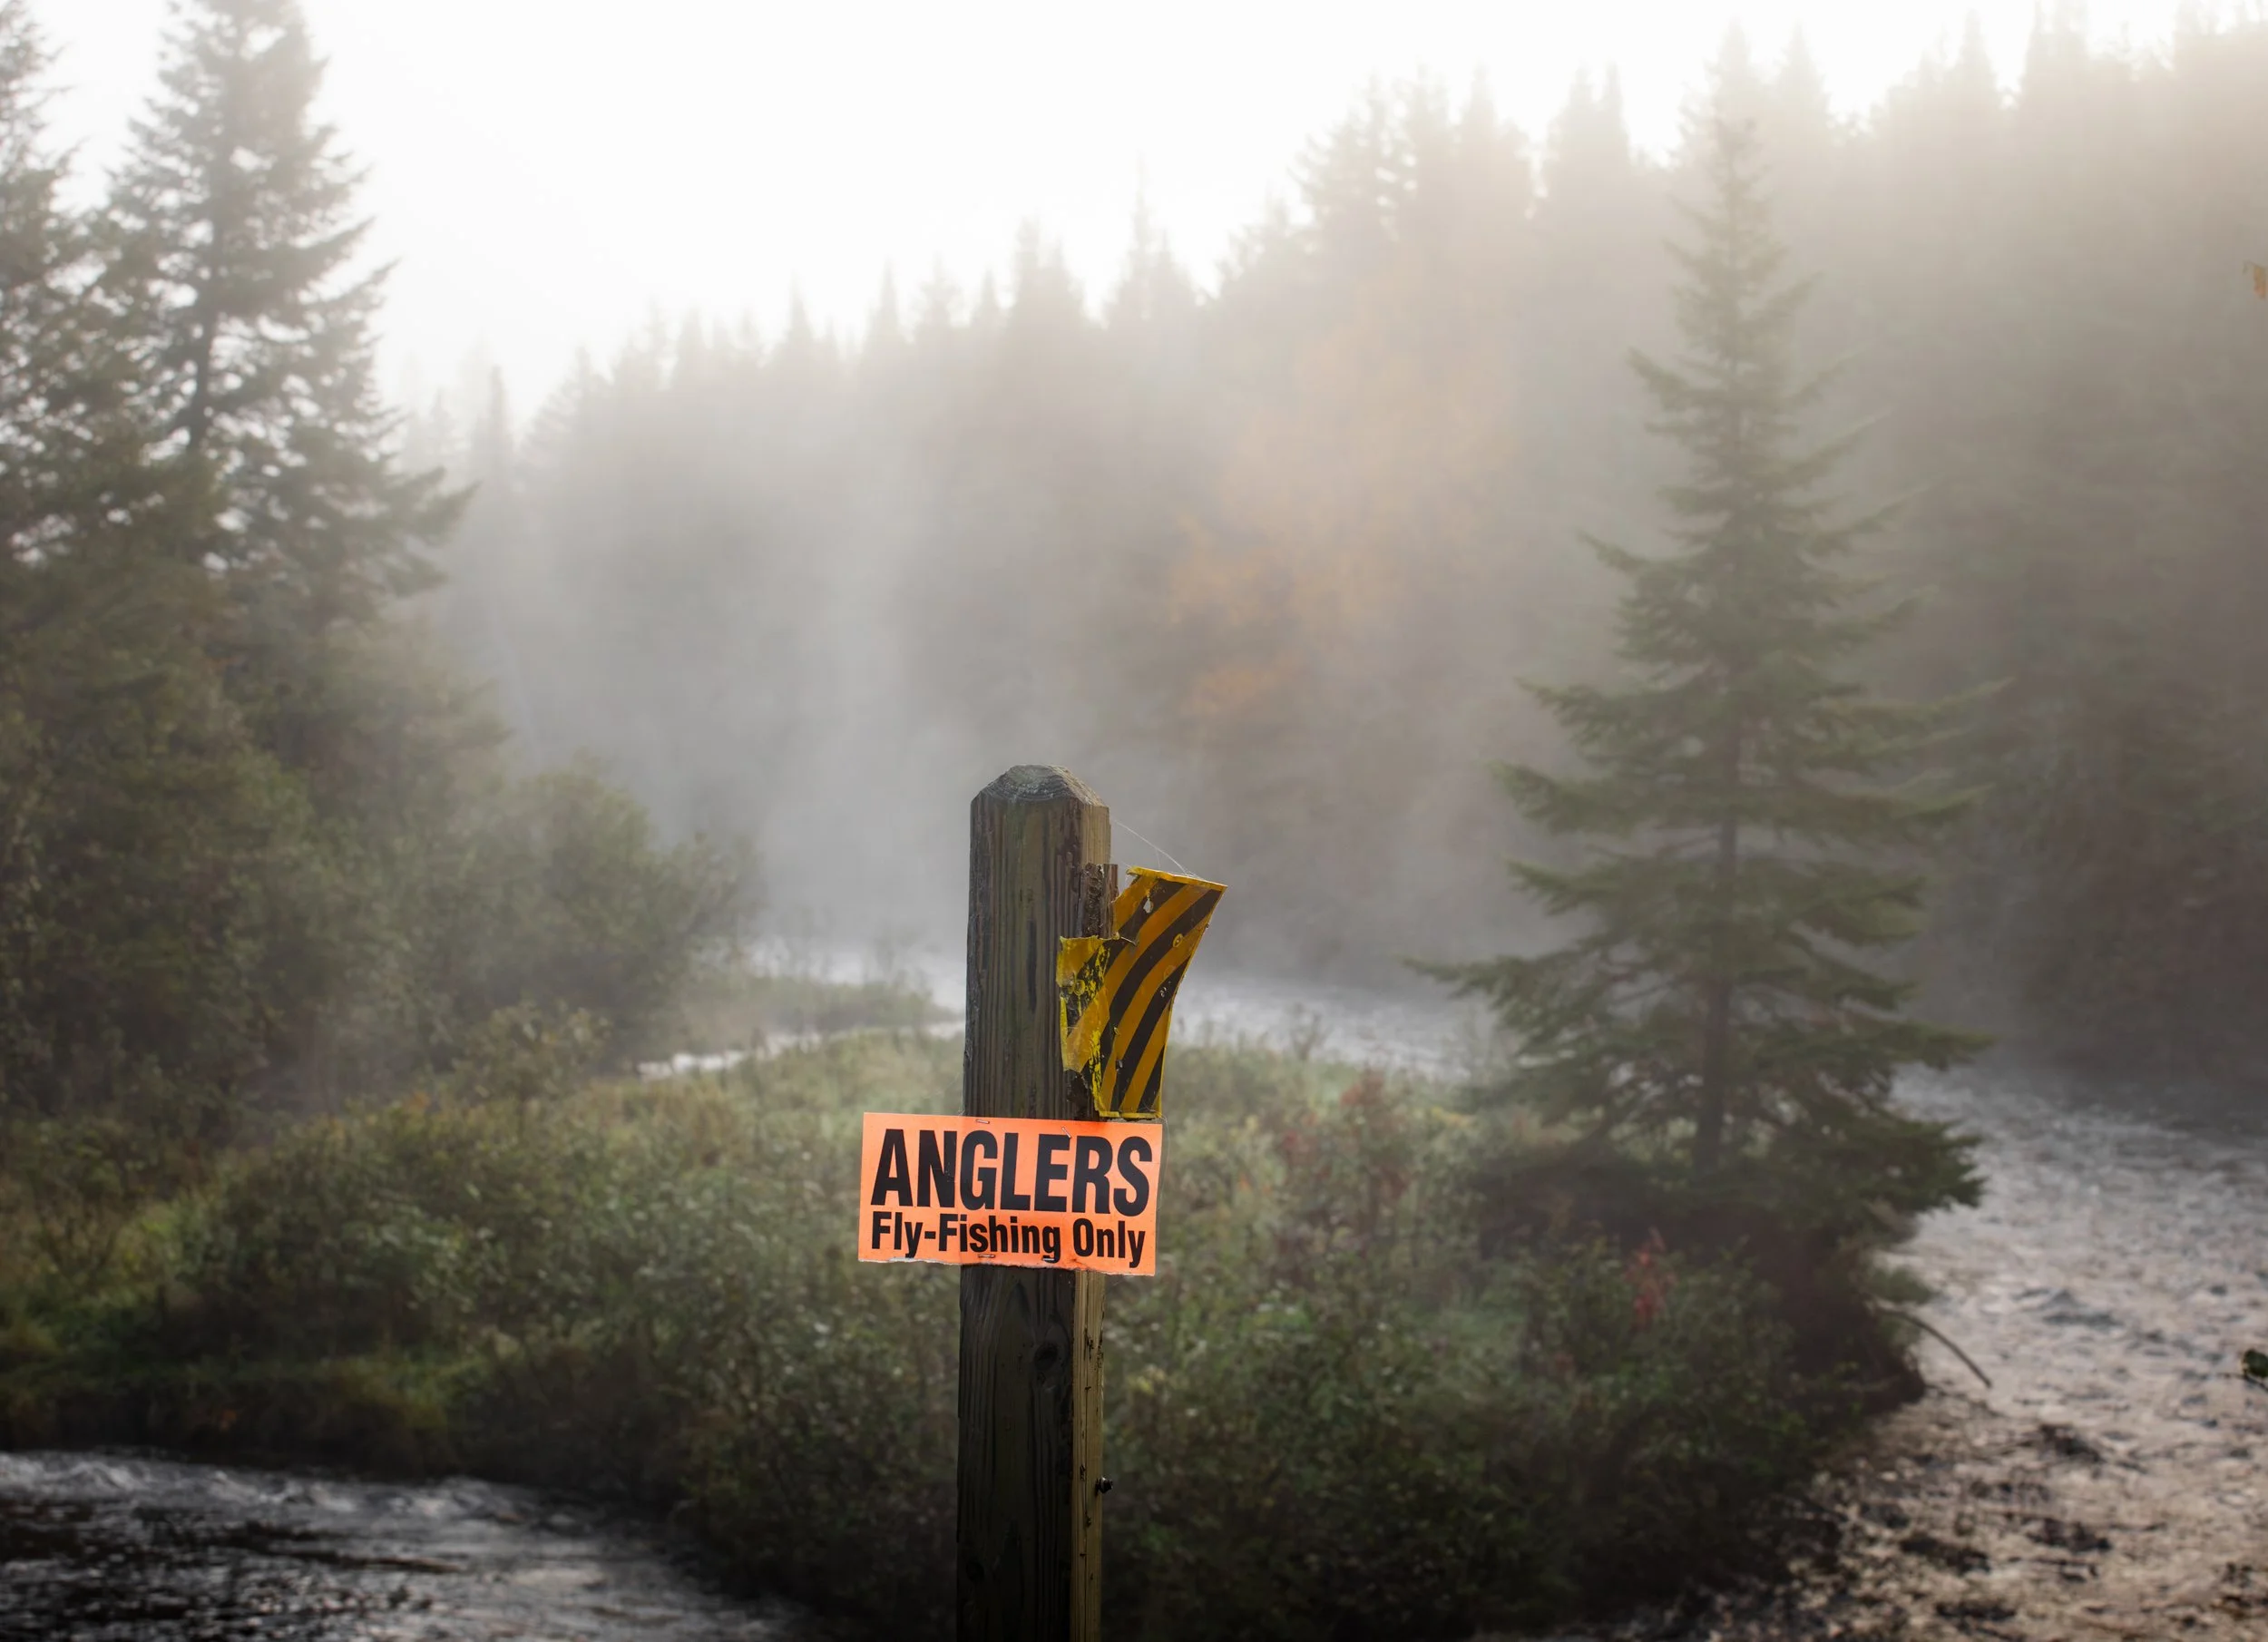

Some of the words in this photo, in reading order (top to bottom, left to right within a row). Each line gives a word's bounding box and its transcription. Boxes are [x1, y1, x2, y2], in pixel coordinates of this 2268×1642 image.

[871, 1129, 1152, 1217] ANGLERS
[871, 1211, 1061, 1263] Fly-Fishing
[1072, 1217, 1146, 1268] Only
